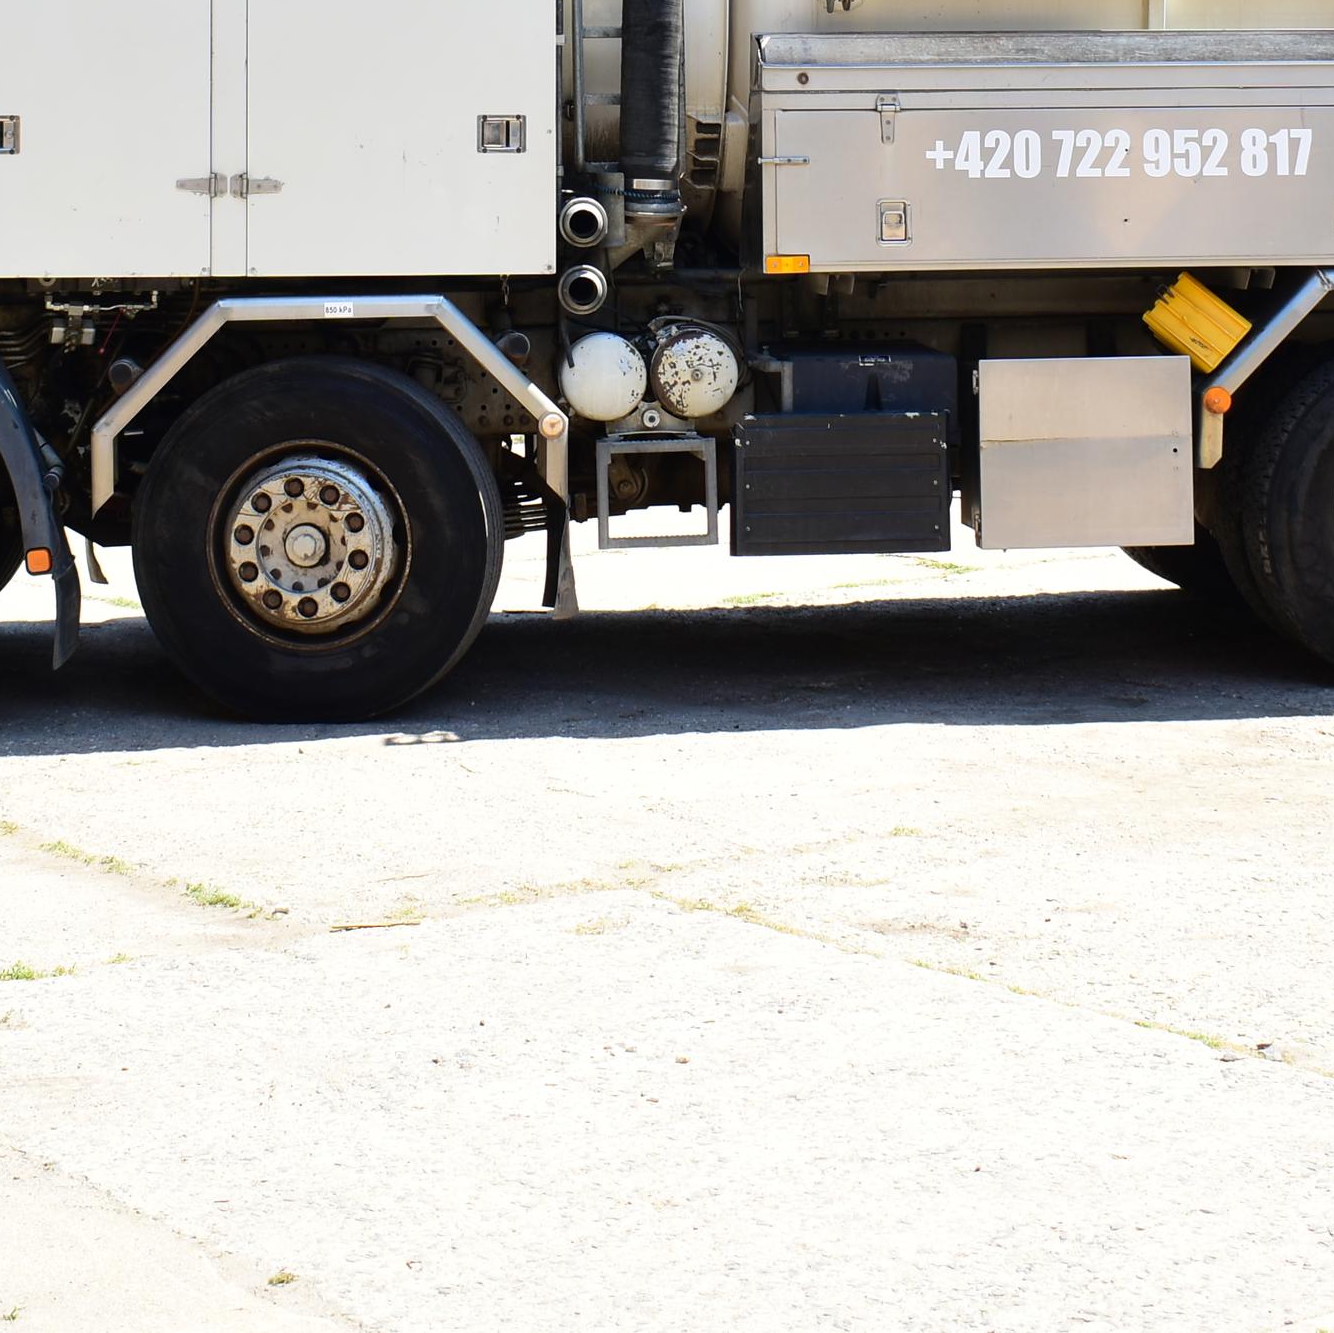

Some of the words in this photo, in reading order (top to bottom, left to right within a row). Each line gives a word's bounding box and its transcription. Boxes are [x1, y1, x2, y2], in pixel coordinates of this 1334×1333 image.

[925, 129, 1042, 179] +420
[1051, 128, 1131, 178] 722
[1142, 128, 1229, 178] 952
[1240, 128, 1313, 177] 817
